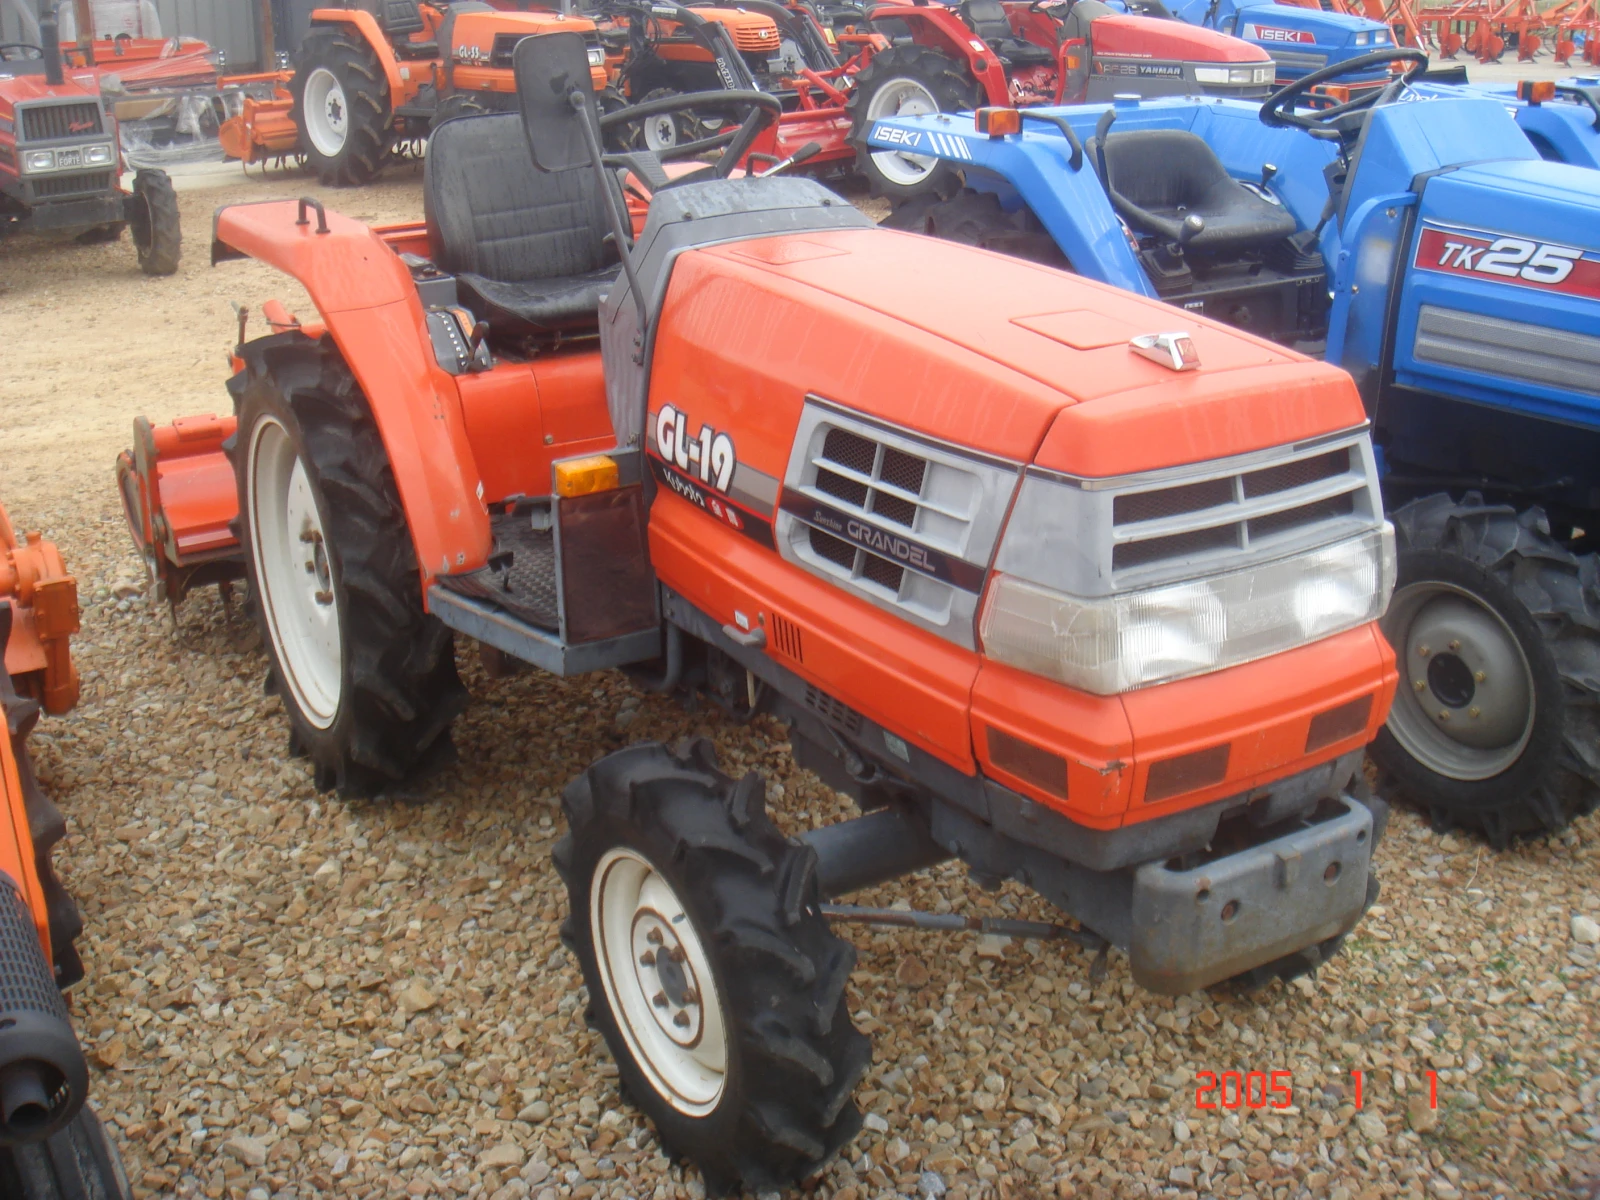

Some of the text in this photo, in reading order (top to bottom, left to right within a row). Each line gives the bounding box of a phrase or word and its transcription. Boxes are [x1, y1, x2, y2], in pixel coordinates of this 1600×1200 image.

[1260, 29, 1301, 42] ISEKI
[1140, 66, 1181, 75] YANMAR
[874, 125, 922, 147] ISEKI
[1438, 238, 1584, 284] TK25
[656, 403, 736, 494] GL-19
[847, 520, 936, 572] GRANDEL
